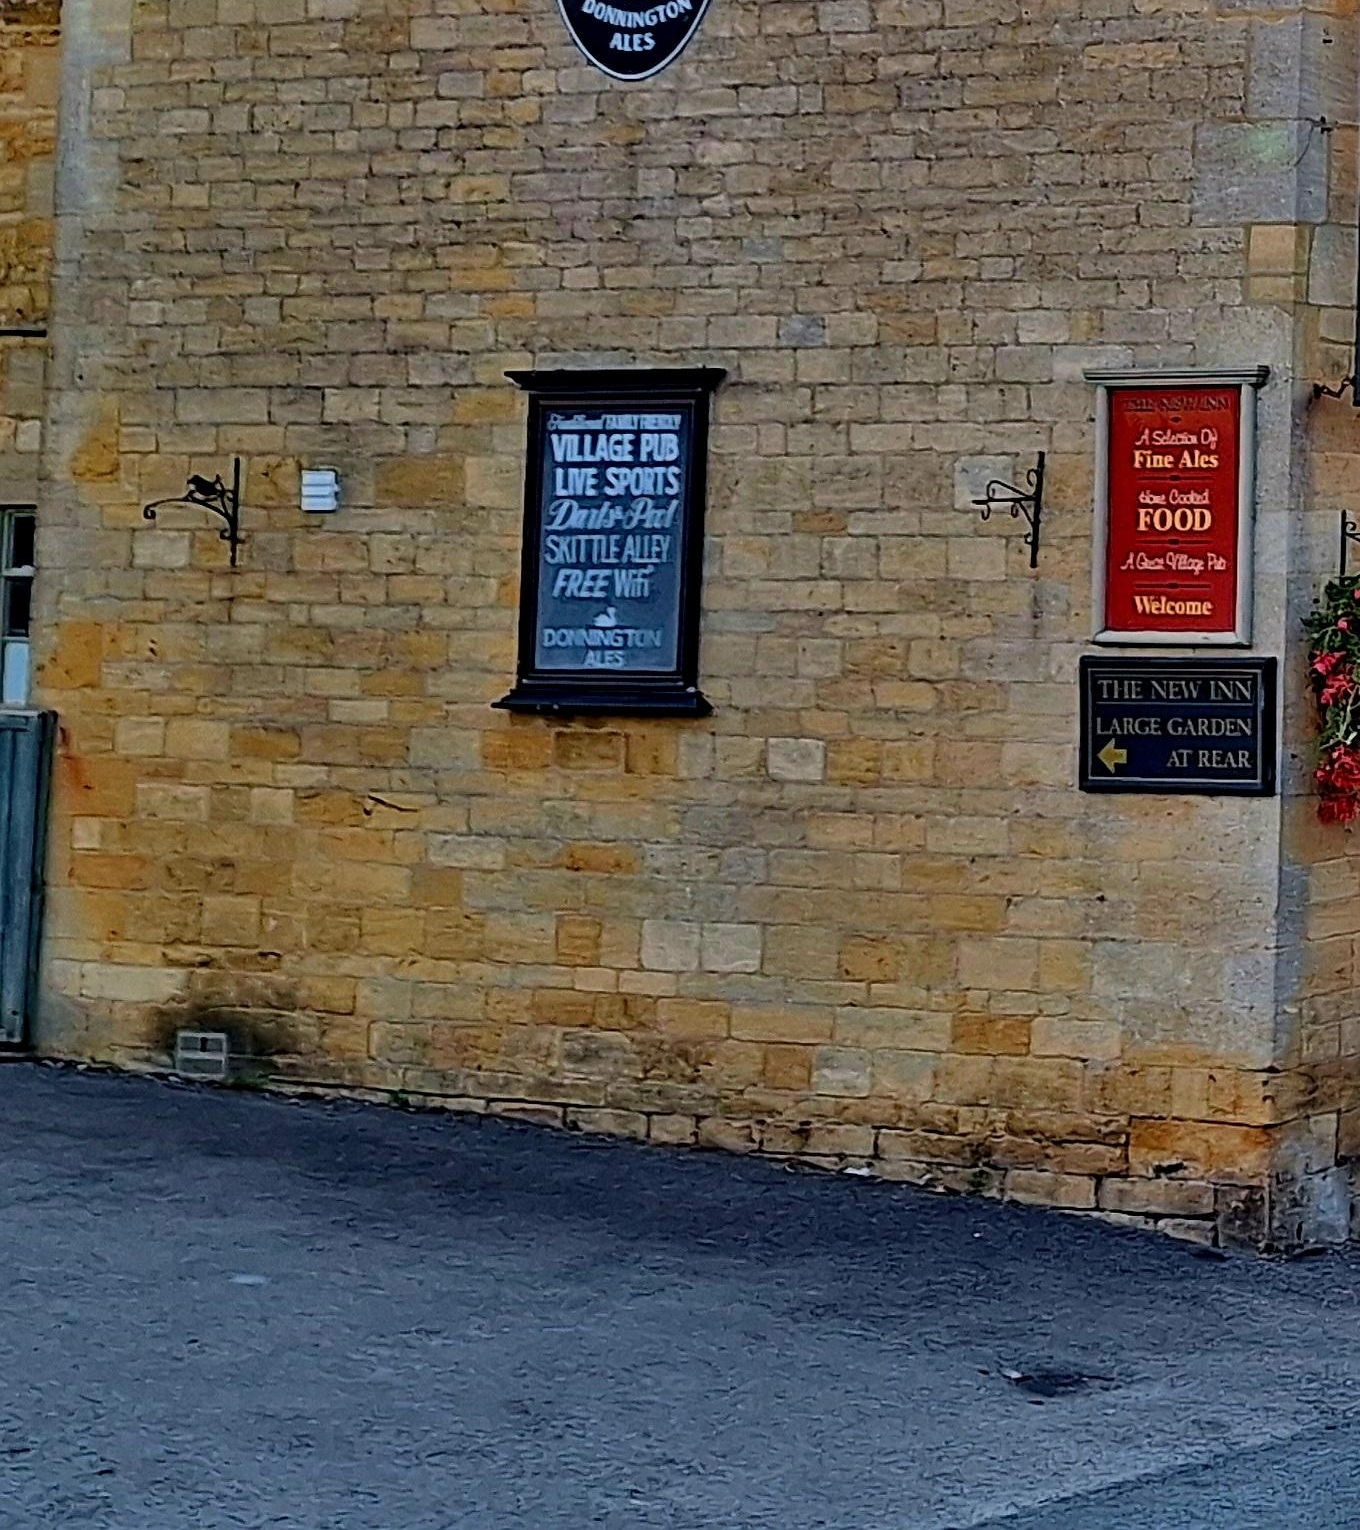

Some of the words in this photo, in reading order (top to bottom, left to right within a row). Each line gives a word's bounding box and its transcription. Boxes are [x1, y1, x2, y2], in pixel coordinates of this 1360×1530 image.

[609, 33, 655, 52] ALES
[551, 433, 635, 462] VILLAGE
[639, 433, 680, 462] PUB
[1133, 449, 1175, 469] Fine
[1178, 449, 1219, 469] Ales
[555, 467, 599, 496] LIVE
[604, 466, 681, 496] SPORTS
[1136, 508, 1212, 532] FOOD
[544, 534, 621, 564] SKITTLE
[621, 534, 671, 563] ALLEY
[551, 568, 612, 598] FREE
[1133, 595, 1214, 615] Welcome
[542, 628, 662, 648] DONNINGTON
[583, 649, 625, 667] ALES
[1097, 679, 1143, 699] THE
[1151, 680, 1202, 700] NEW
[1209, 680, 1253, 701] INN
[1096, 717, 1162, 735] LARGE
[1166, 717, 1253, 737] GARDEN
[1166, 749, 1192, 768] AT
[1198, 749, 1253, 769] REAR
